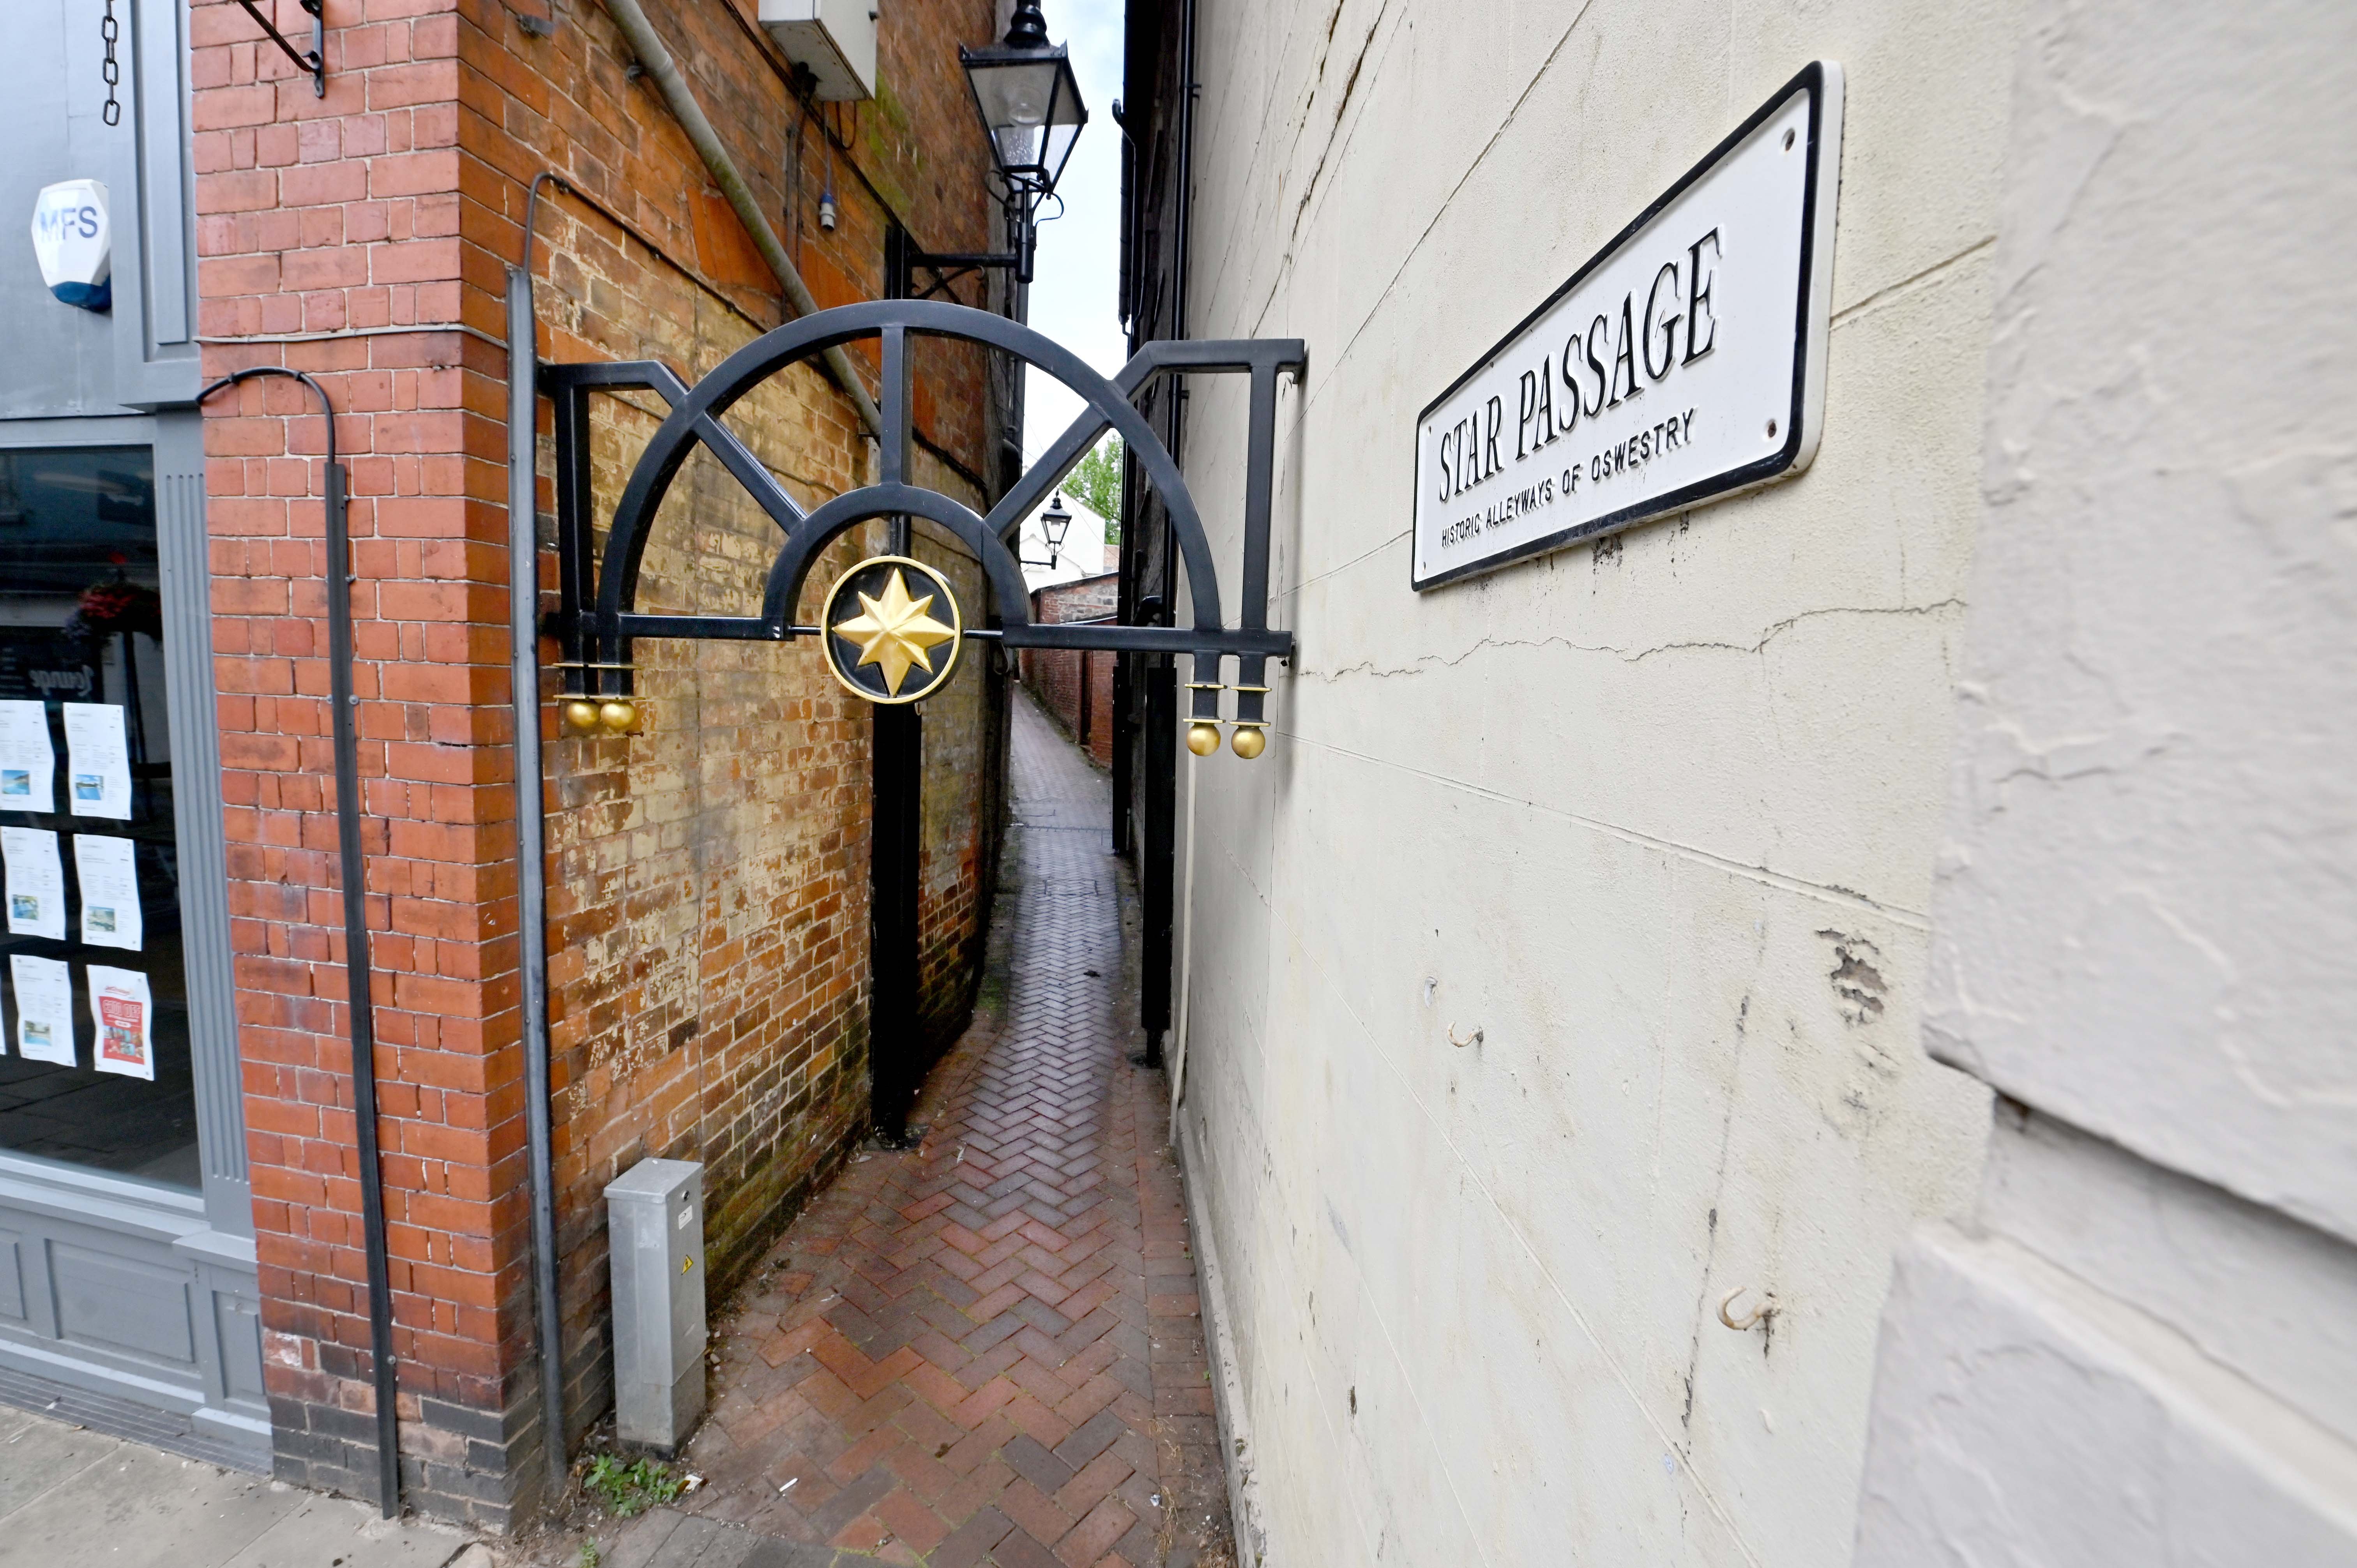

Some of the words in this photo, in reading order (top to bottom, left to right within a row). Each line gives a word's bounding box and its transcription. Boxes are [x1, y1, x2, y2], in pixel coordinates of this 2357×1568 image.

[39, 206, 98, 243] MFS
[1439, 395, 1504, 502] STAR
[1516, 226, 1723, 461] PASSAGE
[1442, 515, 1481, 547] HISTORIC
[1486, 477, 1553, 529] ALLEYWAYS
[1562, 463, 1581, 494] OF
[1591, 407, 1694, 482] OSWESTRY
